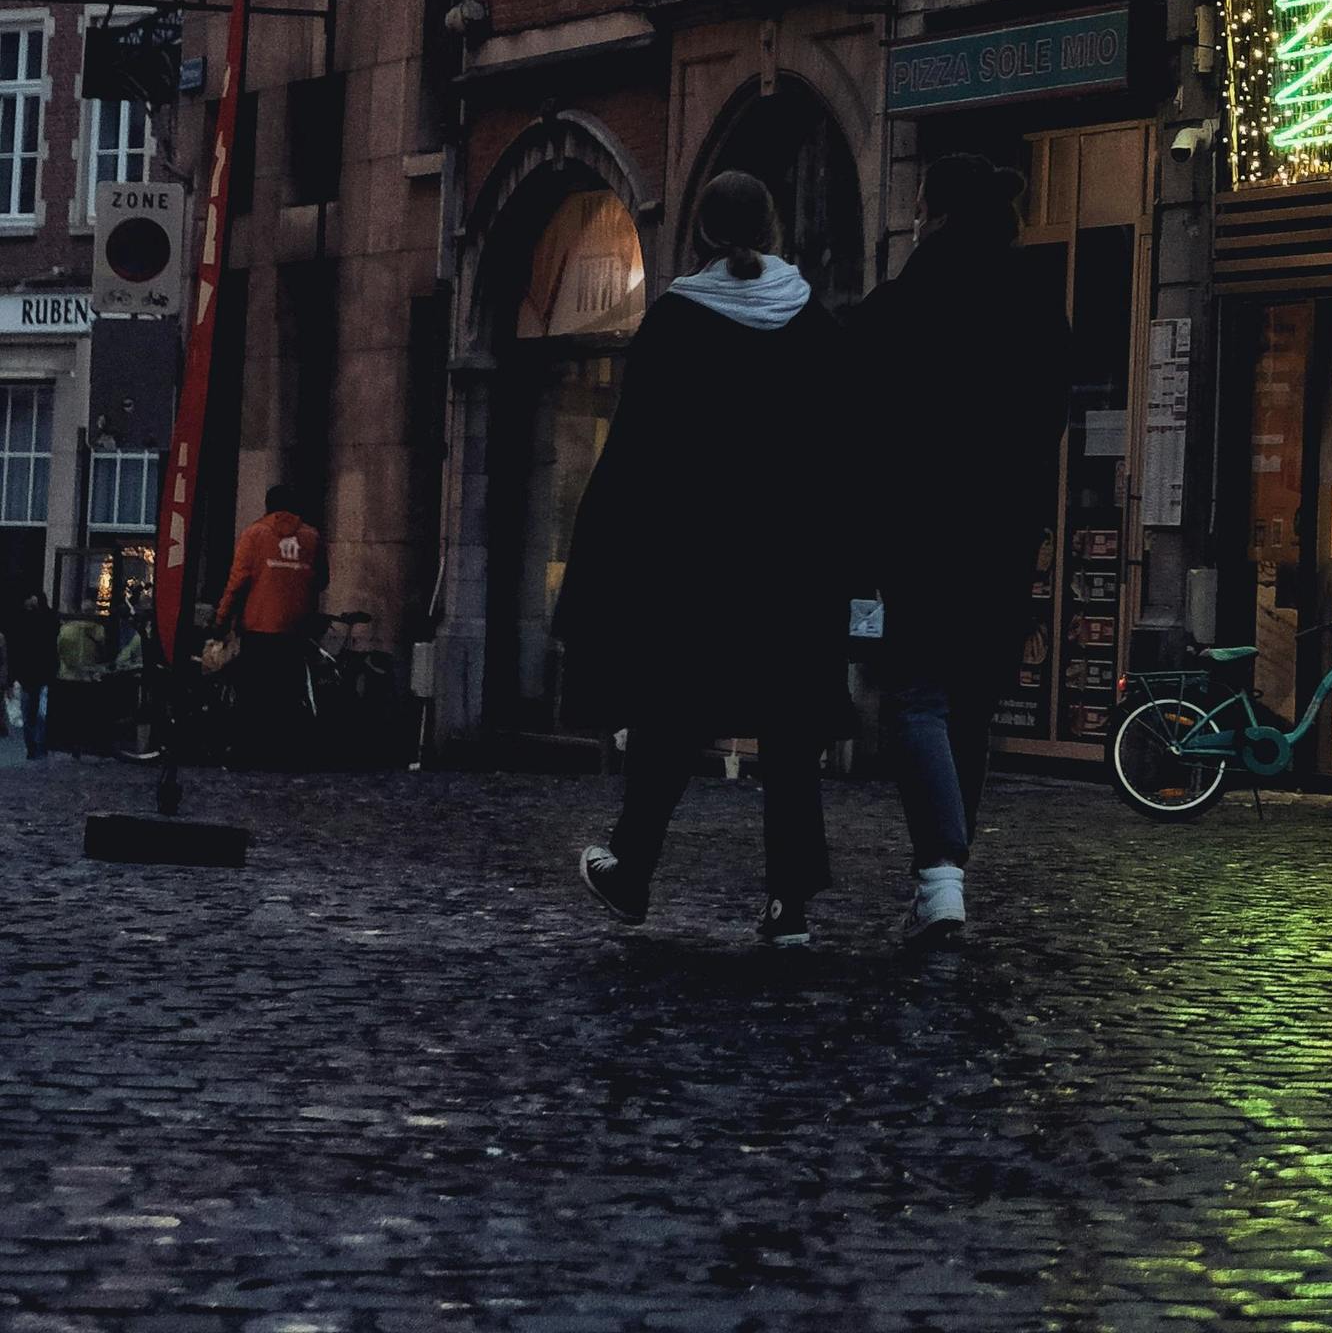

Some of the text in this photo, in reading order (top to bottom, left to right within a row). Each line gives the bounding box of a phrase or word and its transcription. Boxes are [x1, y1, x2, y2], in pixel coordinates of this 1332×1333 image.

[892, 28, 1119, 95] PIZZA SOLE MIO
[112, 191, 169, 209] ZONE
[21, 298, 94, 326] RUBEN
